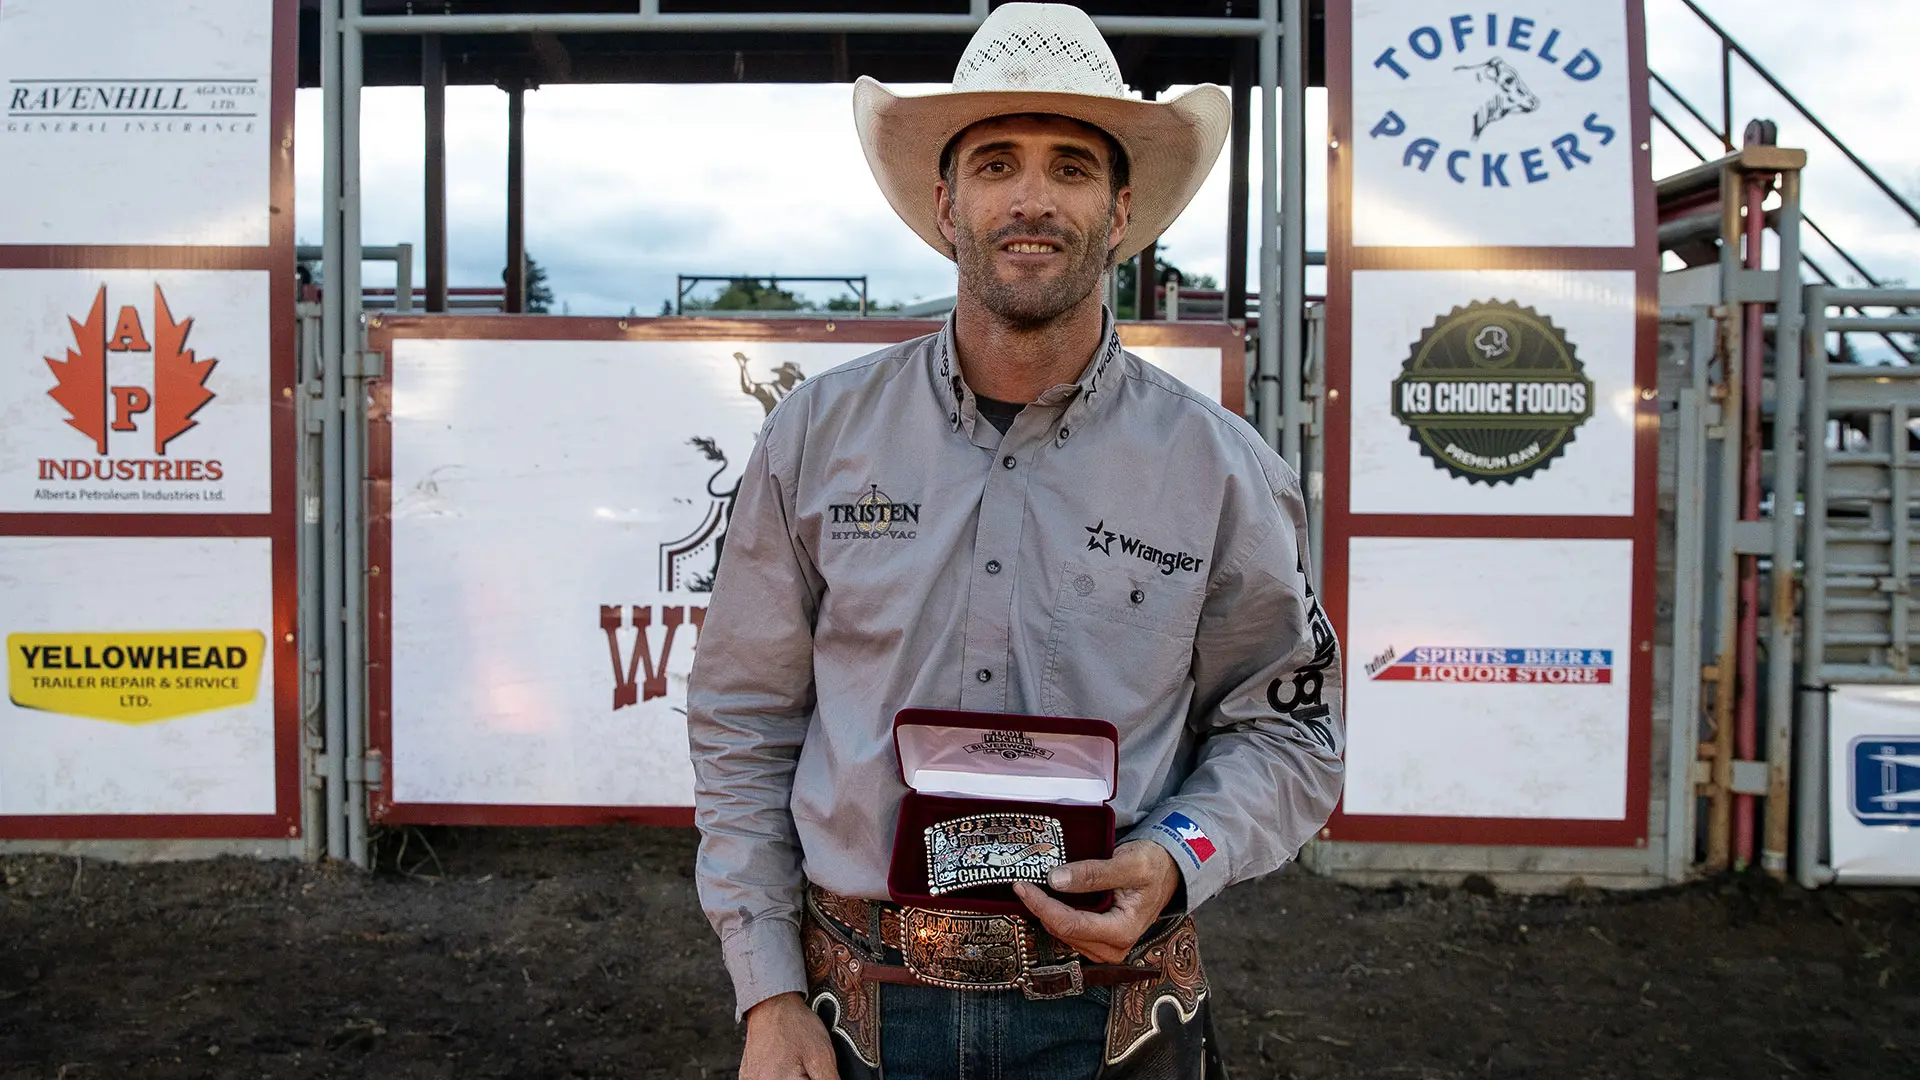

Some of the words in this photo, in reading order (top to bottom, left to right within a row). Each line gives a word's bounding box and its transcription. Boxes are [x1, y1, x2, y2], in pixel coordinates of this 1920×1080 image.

[1373, 13, 1603, 82] TOFIELD
[9, 87, 188, 110] RAVENHILL
[7, 122, 108, 133] GENERAL
[123, 122, 255, 133] INSURANCE
[1369, 110, 1616, 188] PACKERS
[107, 305, 152, 352] A
[1402, 382, 1431, 413] K9
[1434, 382, 1513, 413] CHOICE
[1515, 382, 1586, 413] FOODS
[110, 386, 151, 432] P
[1445, 443, 1507, 469] PREMIUM
[38, 459, 223, 481] INDUSTRIES
[34, 488, 77, 500] Alberta
[79, 488, 140, 500] Petroleum
[142, 488, 200, 500] Industries
[828, 503, 921, 524] TRISTEN
[1119, 534, 1204, 576] Wrangler
[20, 645, 247, 669] YELLOWHEAD
[1415, 648, 1506, 664] SPIRITS
[1524, 650, 1585, 664] BEER
[32, 676, 96, 689] TRAILER
[101, 676, 156, 689] REPAIR
[159, 676, 171, 689] &
[176, 676, 239, 689] SERVICE
[1414, 665, 1510, 682] LIQUOR
[1515, 667, 1599, 683] STORE
[120, 696, 152, 707] LTD.
[971, 743, 1047, 756] SILVERWORKS
[945, 817, 1044, 837] TOFIELD
[998, 831, 1032, 844] BASH
[958, 866, 1041, 883] CHAMPION
